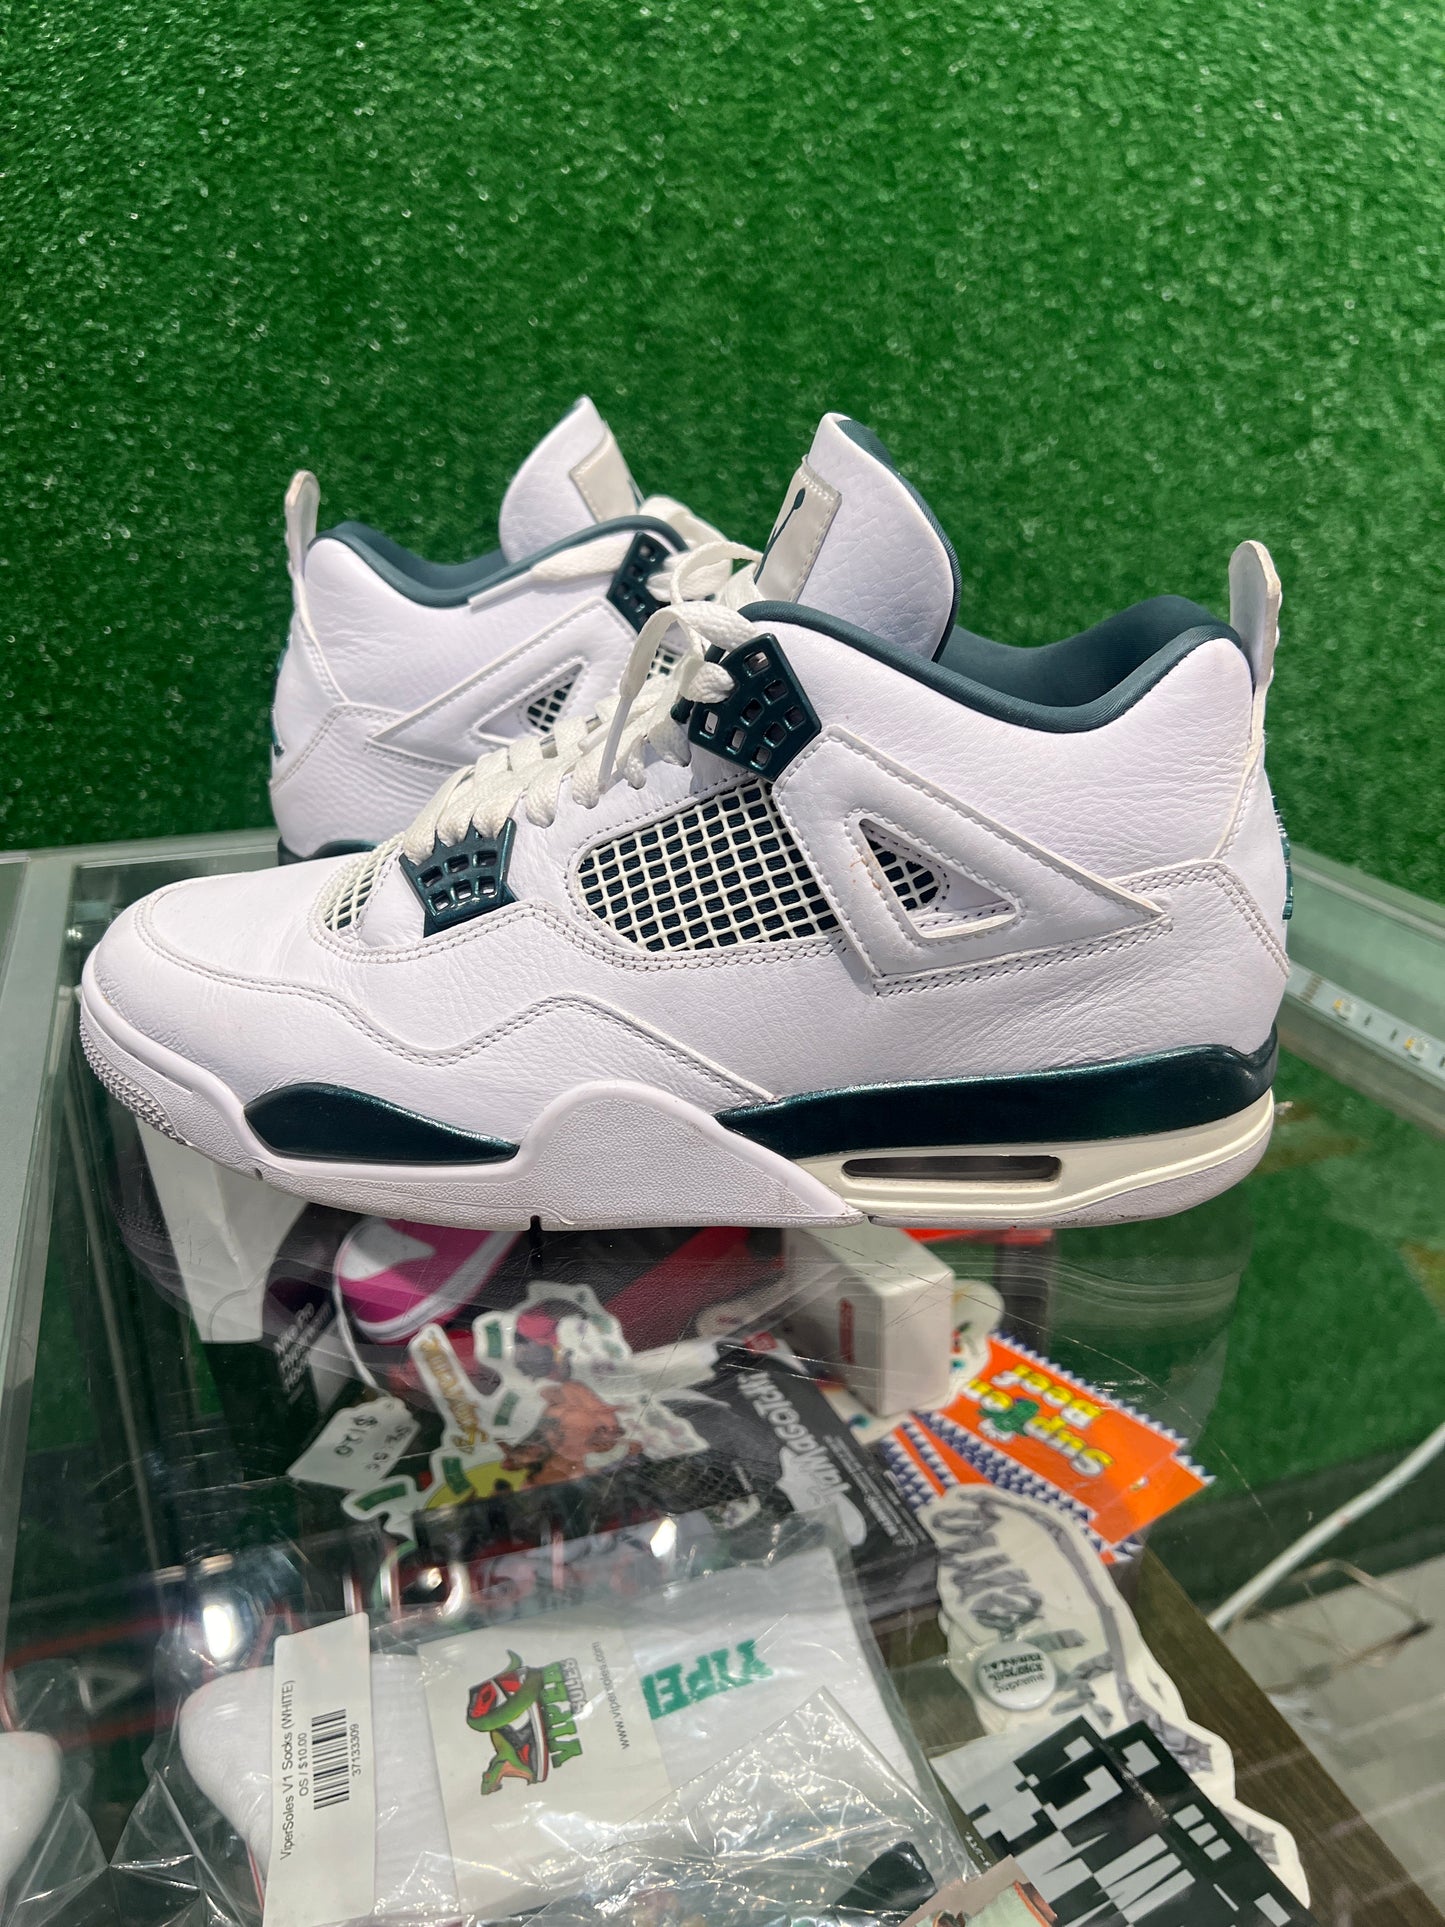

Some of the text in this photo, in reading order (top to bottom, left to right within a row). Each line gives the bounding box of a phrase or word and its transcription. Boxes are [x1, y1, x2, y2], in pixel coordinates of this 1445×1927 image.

[990, 1363, 1104, 1430] Beef
[280, 1680, 296, 1861] ViperSoles V1 Socks (WHITE)
[297, 1732, 308, 1768] $10.00
[349, 1723, 361, 1777] 37133309
[299, 1780, 309, 1797] OS
